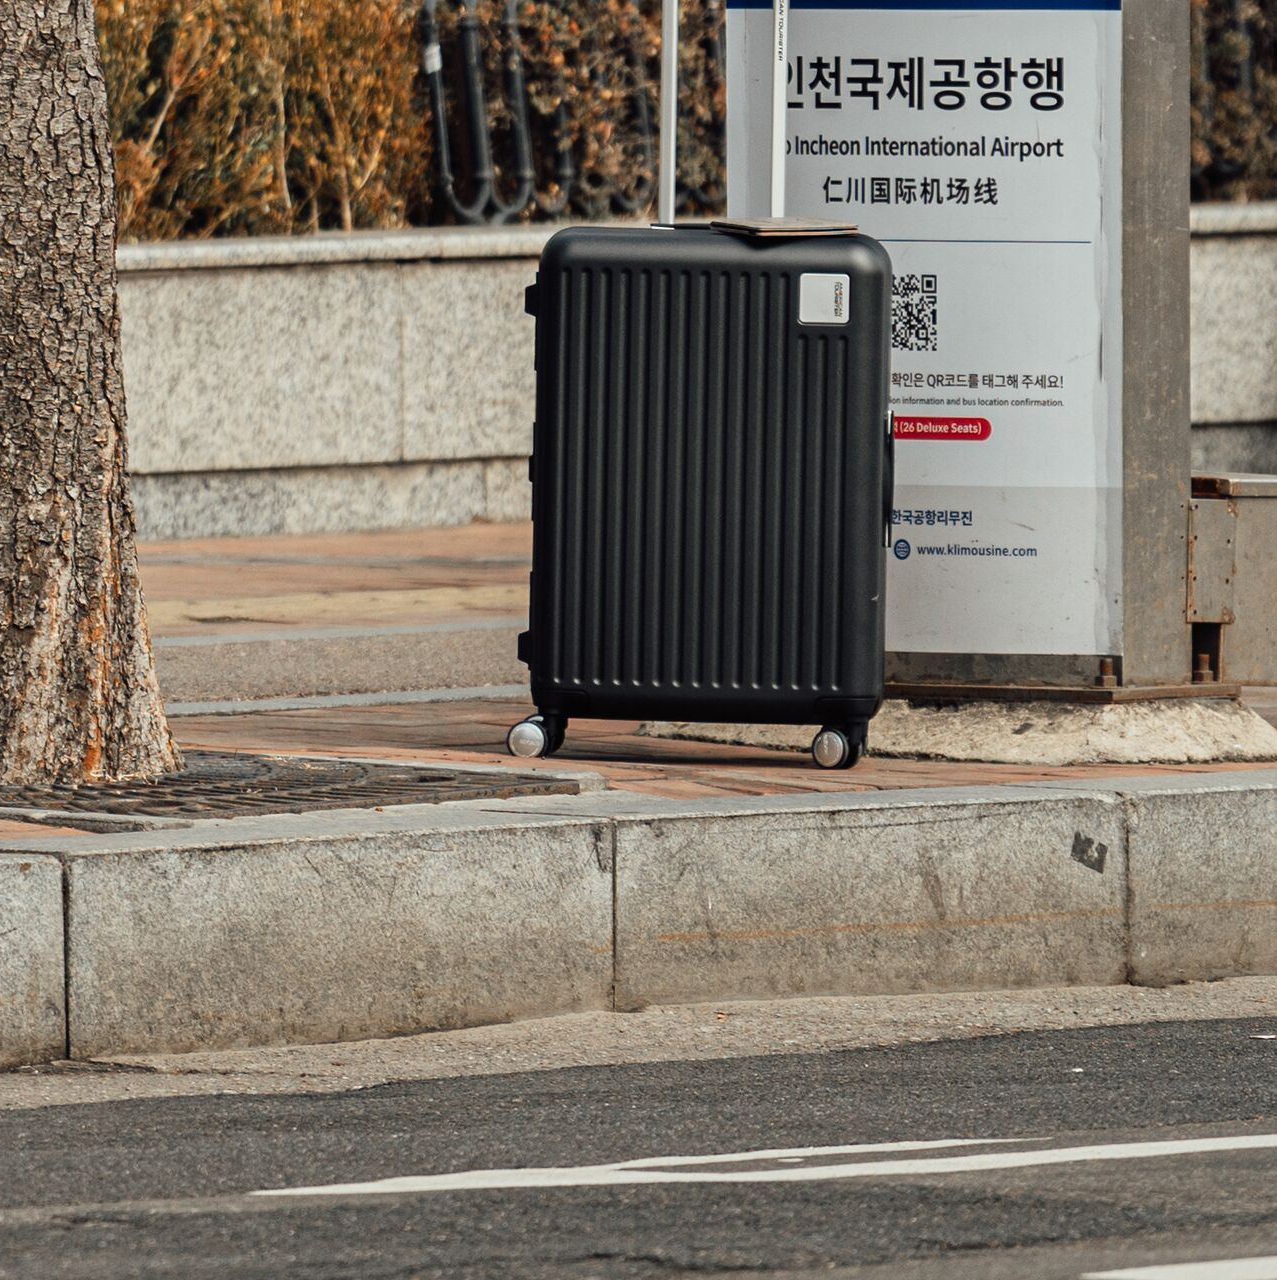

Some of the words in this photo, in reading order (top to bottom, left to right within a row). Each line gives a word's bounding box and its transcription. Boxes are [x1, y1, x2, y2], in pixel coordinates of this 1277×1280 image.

[795, 135, 860, 155] Incheon
[865, 136, 986, 157] International
[990, 137, 1064, 162] Airport
[823, 176, 998, 205] 仁川国际机场线
[891, 372, 924, 387] 확인은
[927, 374, 980, 389] QR코드를
[982, 374, 1018, 389] 태그해
[1022, 375, 1064, 389] 주세요!
[902, 397, 944, 406] information
[946, 398, 960, 406] and
[962, 398, 976, 406] bus
[977, 398, 1009, 406] location
[1011, 398, 1065, 407] confirmation.
[900, 421, 915, 433] (26
[916, 422, 949, 433] Deluxe
[951, 422, 982, 434] Seats)
[892, 510, 973, 526] 한국공항리무진
[917, 543, 1037, 557] www.klimousine.com
